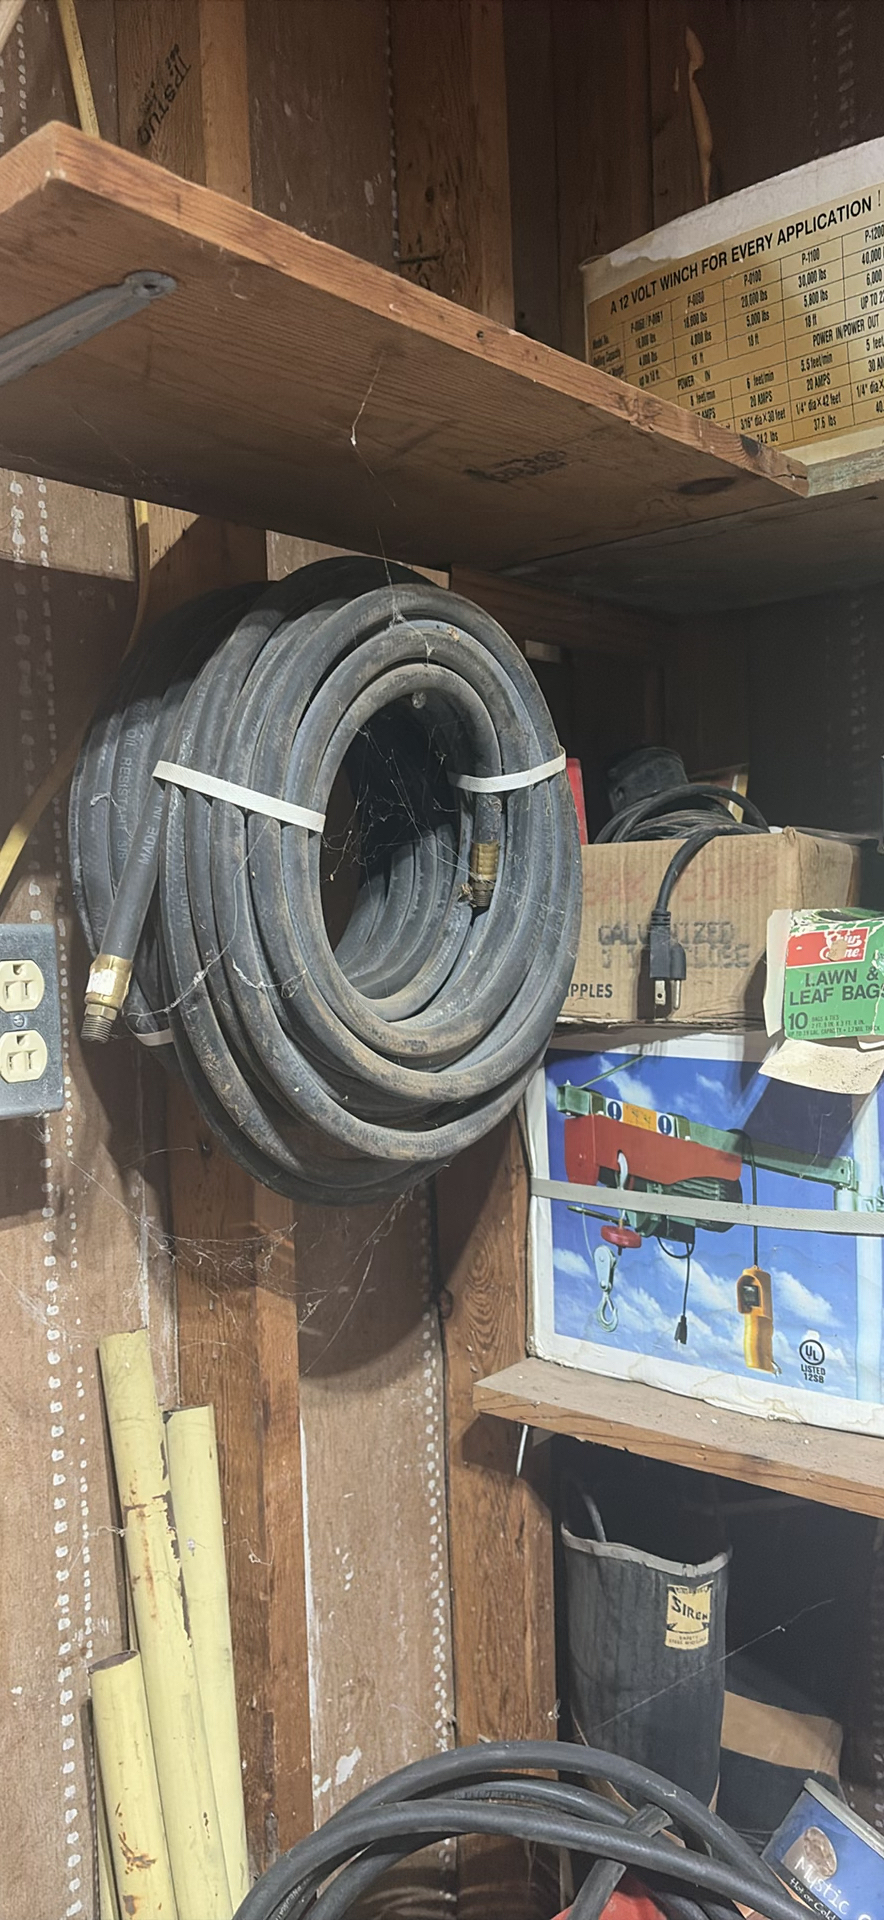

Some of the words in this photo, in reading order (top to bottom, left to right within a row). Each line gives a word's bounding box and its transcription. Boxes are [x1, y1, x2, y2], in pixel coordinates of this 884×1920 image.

[610, 300, 617, 315] A
[619, 295, 629, 310] 12
[630, 280, 657, 305] VOLT
[659, 262, 698, 292] WINCH
[701, 251, 728, 275] FOR
[731, 232, 773, 262] EVERY
[776, 195, 872, 246] APPLICATION
[801, 247, 820, 265] P-1100
[818, 268, 827, 281] lbs
[760, 289, 768, 302] lbs
[820, 289, 828, 302] lbs
[860, 295, 869, 310] UP
[869, 292, 878, 307] TO
[761, 310, 769, 322] lbs
[812, 329, 834, 348] POWER
[867, 313, 880, 330] OUT
[814, 372, 831, 389] AMPS
[827, 414, 837, 427] lbs
[124, 728, 137, 749] OIL
[137, 827, 159, 865] MADE
[154, 806, 163, 823] IN
[805, 968, 858, 988] LAWN
[866, 966, 879, 982] &
[570, 983, 613, 999] PPLES
[789, 987, 834, 1006] LEAF
[788, 1011, 809, 1031] 10
[801, 1363, 826, 1376] LISTED
[671, 1594, 708, 1621] SIREN
[794, 1856, 850, 1915] Mystic
[789, 1877, 803, 1894] Hot
[803, 1892, 814, 1903] or
[813, 1902, 837, 1920] Cold
